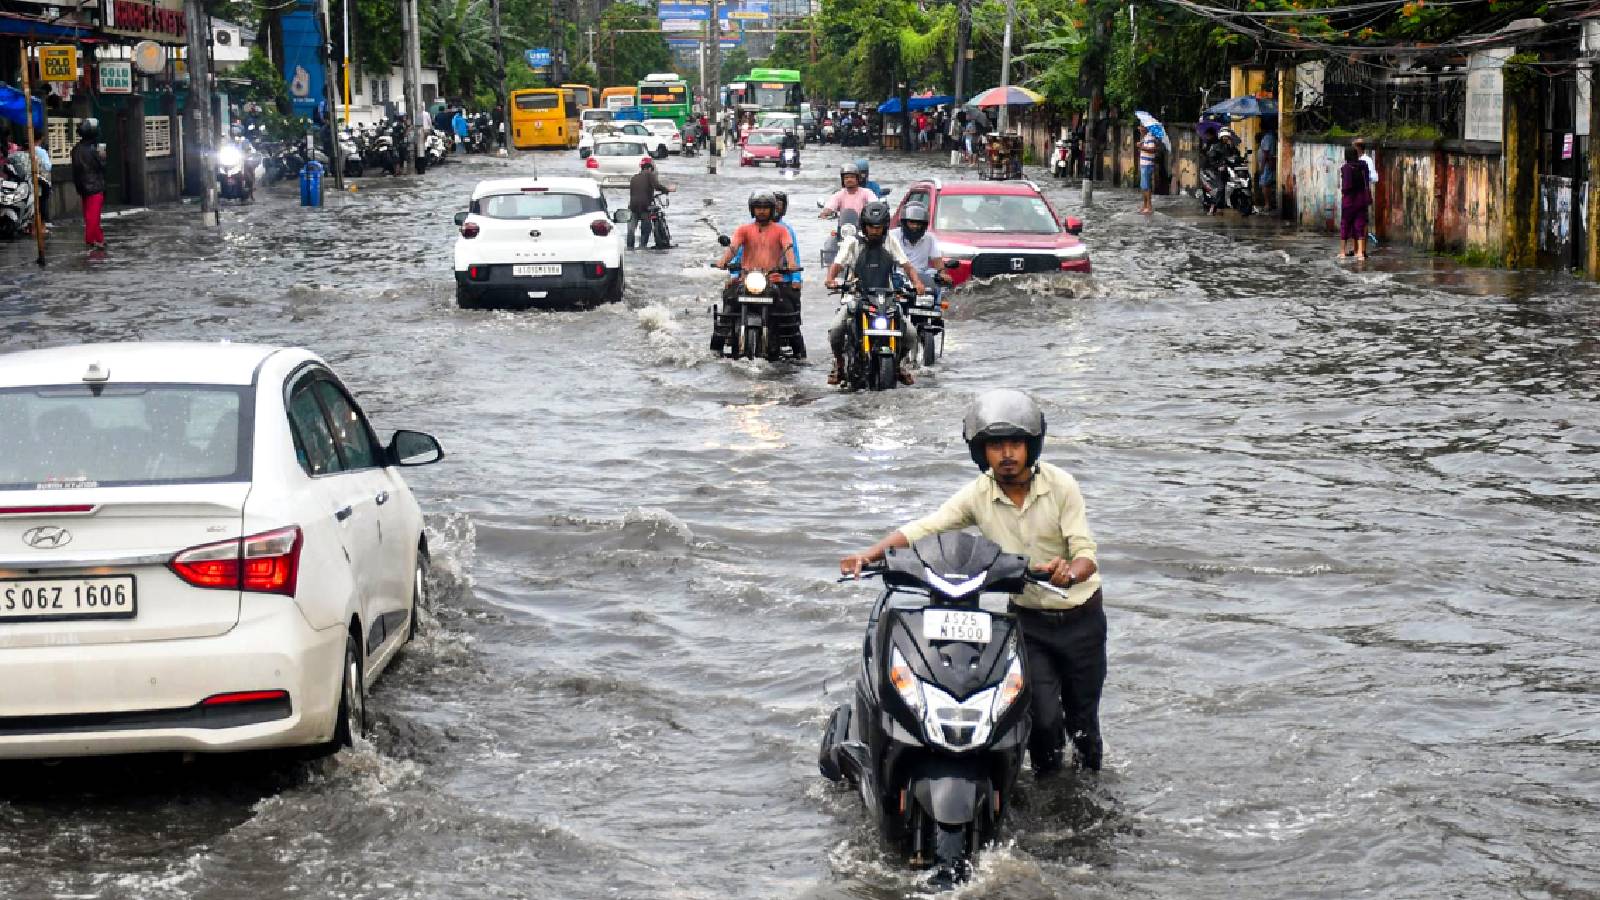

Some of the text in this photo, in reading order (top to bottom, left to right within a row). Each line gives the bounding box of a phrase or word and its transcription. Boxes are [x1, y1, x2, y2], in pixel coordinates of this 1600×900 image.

[45, 57, 70, 66] GOLD
[46, 66, 71, 75] LOAN
[100, 67, 129, 77] GOLD
[101, 77, 129, 88] LOAN
[0, 584, 126, 610] S06Z 1606
[944, 611, 977, 626] AS25
